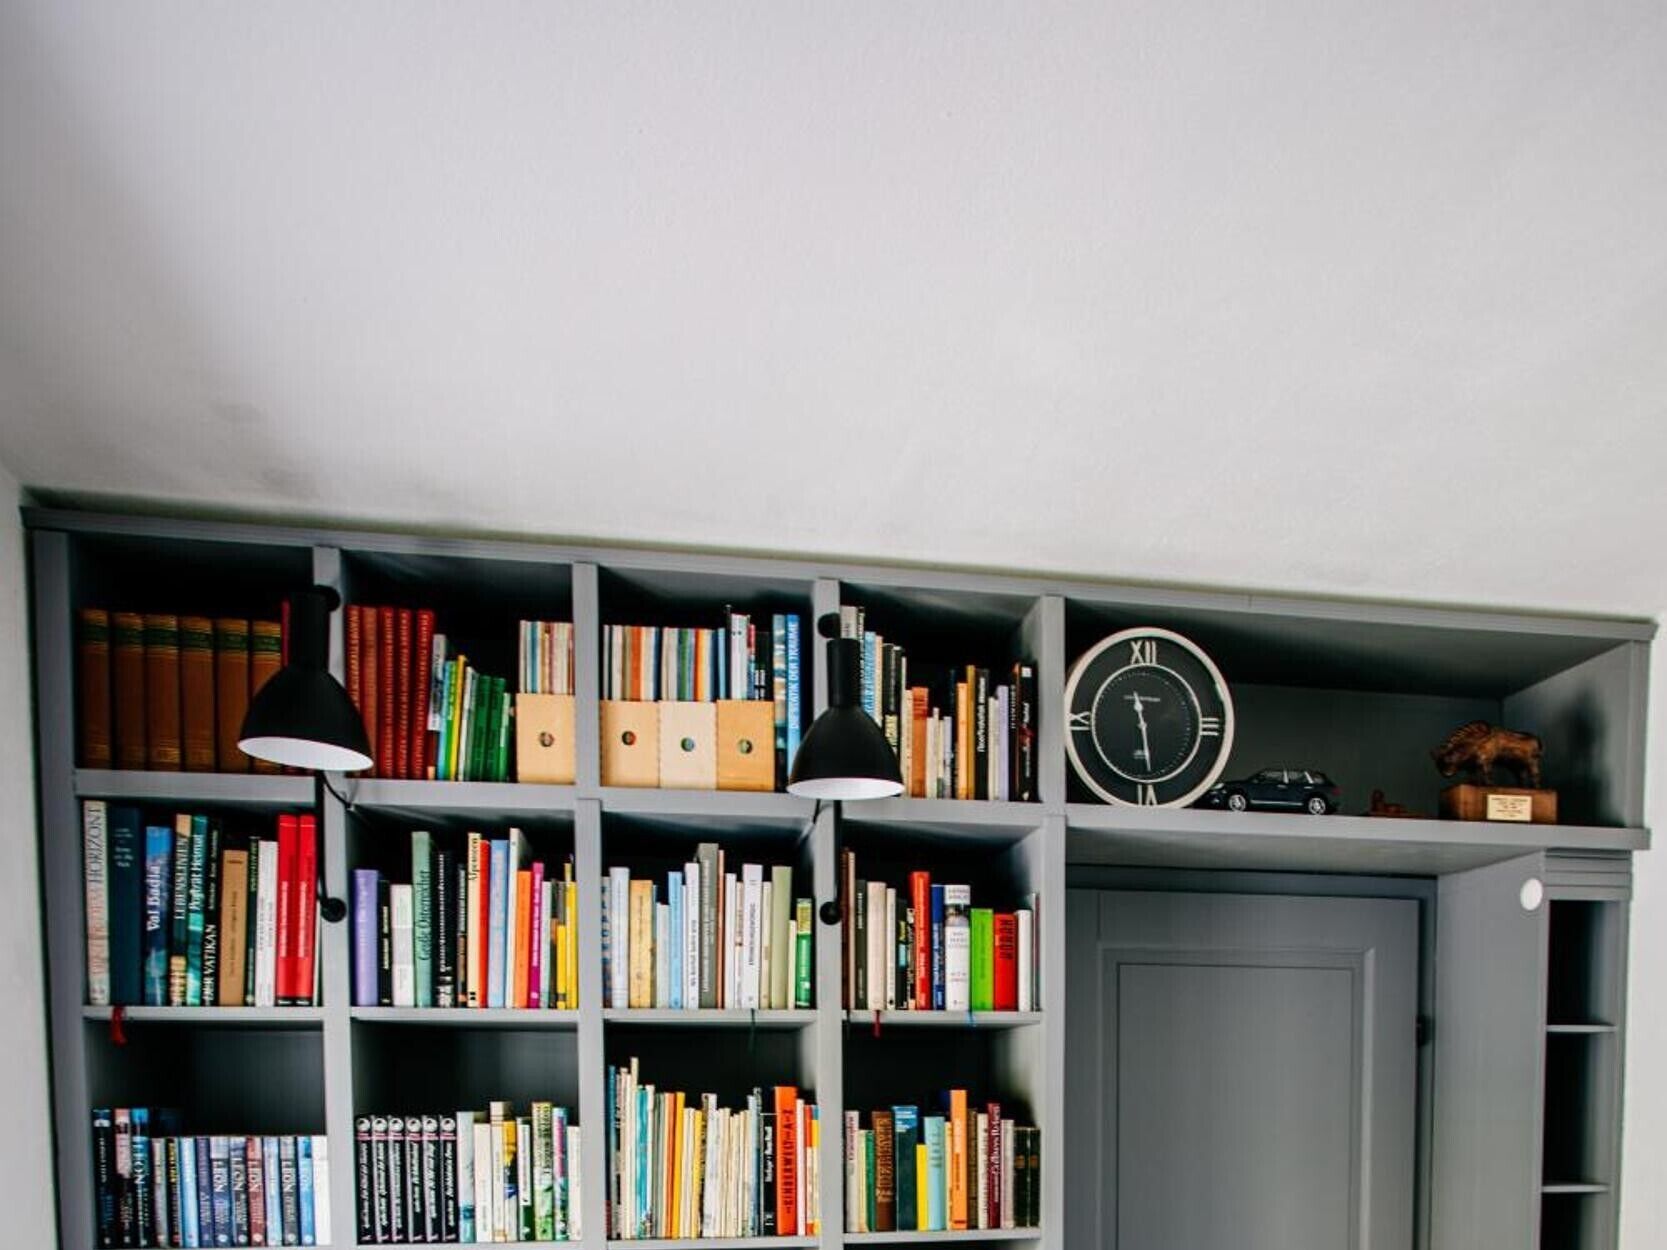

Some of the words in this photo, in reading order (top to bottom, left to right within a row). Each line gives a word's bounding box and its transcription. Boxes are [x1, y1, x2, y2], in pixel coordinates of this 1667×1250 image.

[1130, 641, 1157, 664] XII
[1200, 717, 1221, 737] III
[86, 807, 103, 884] HORIZONT
[145, 864, 161, 906] Badia
[174, 837, 188, 920] LEBENSLINIEN
[145, 908, 161, 931] Val
[203, 923, 217, 975] VATIKAN
[212, 1160, 225, 1192] LEON
[231, 1157, 244, 1191] LEON
[248, 1160, 261, 1192] LEON
[281, 1160, 294, 1192] LEON
